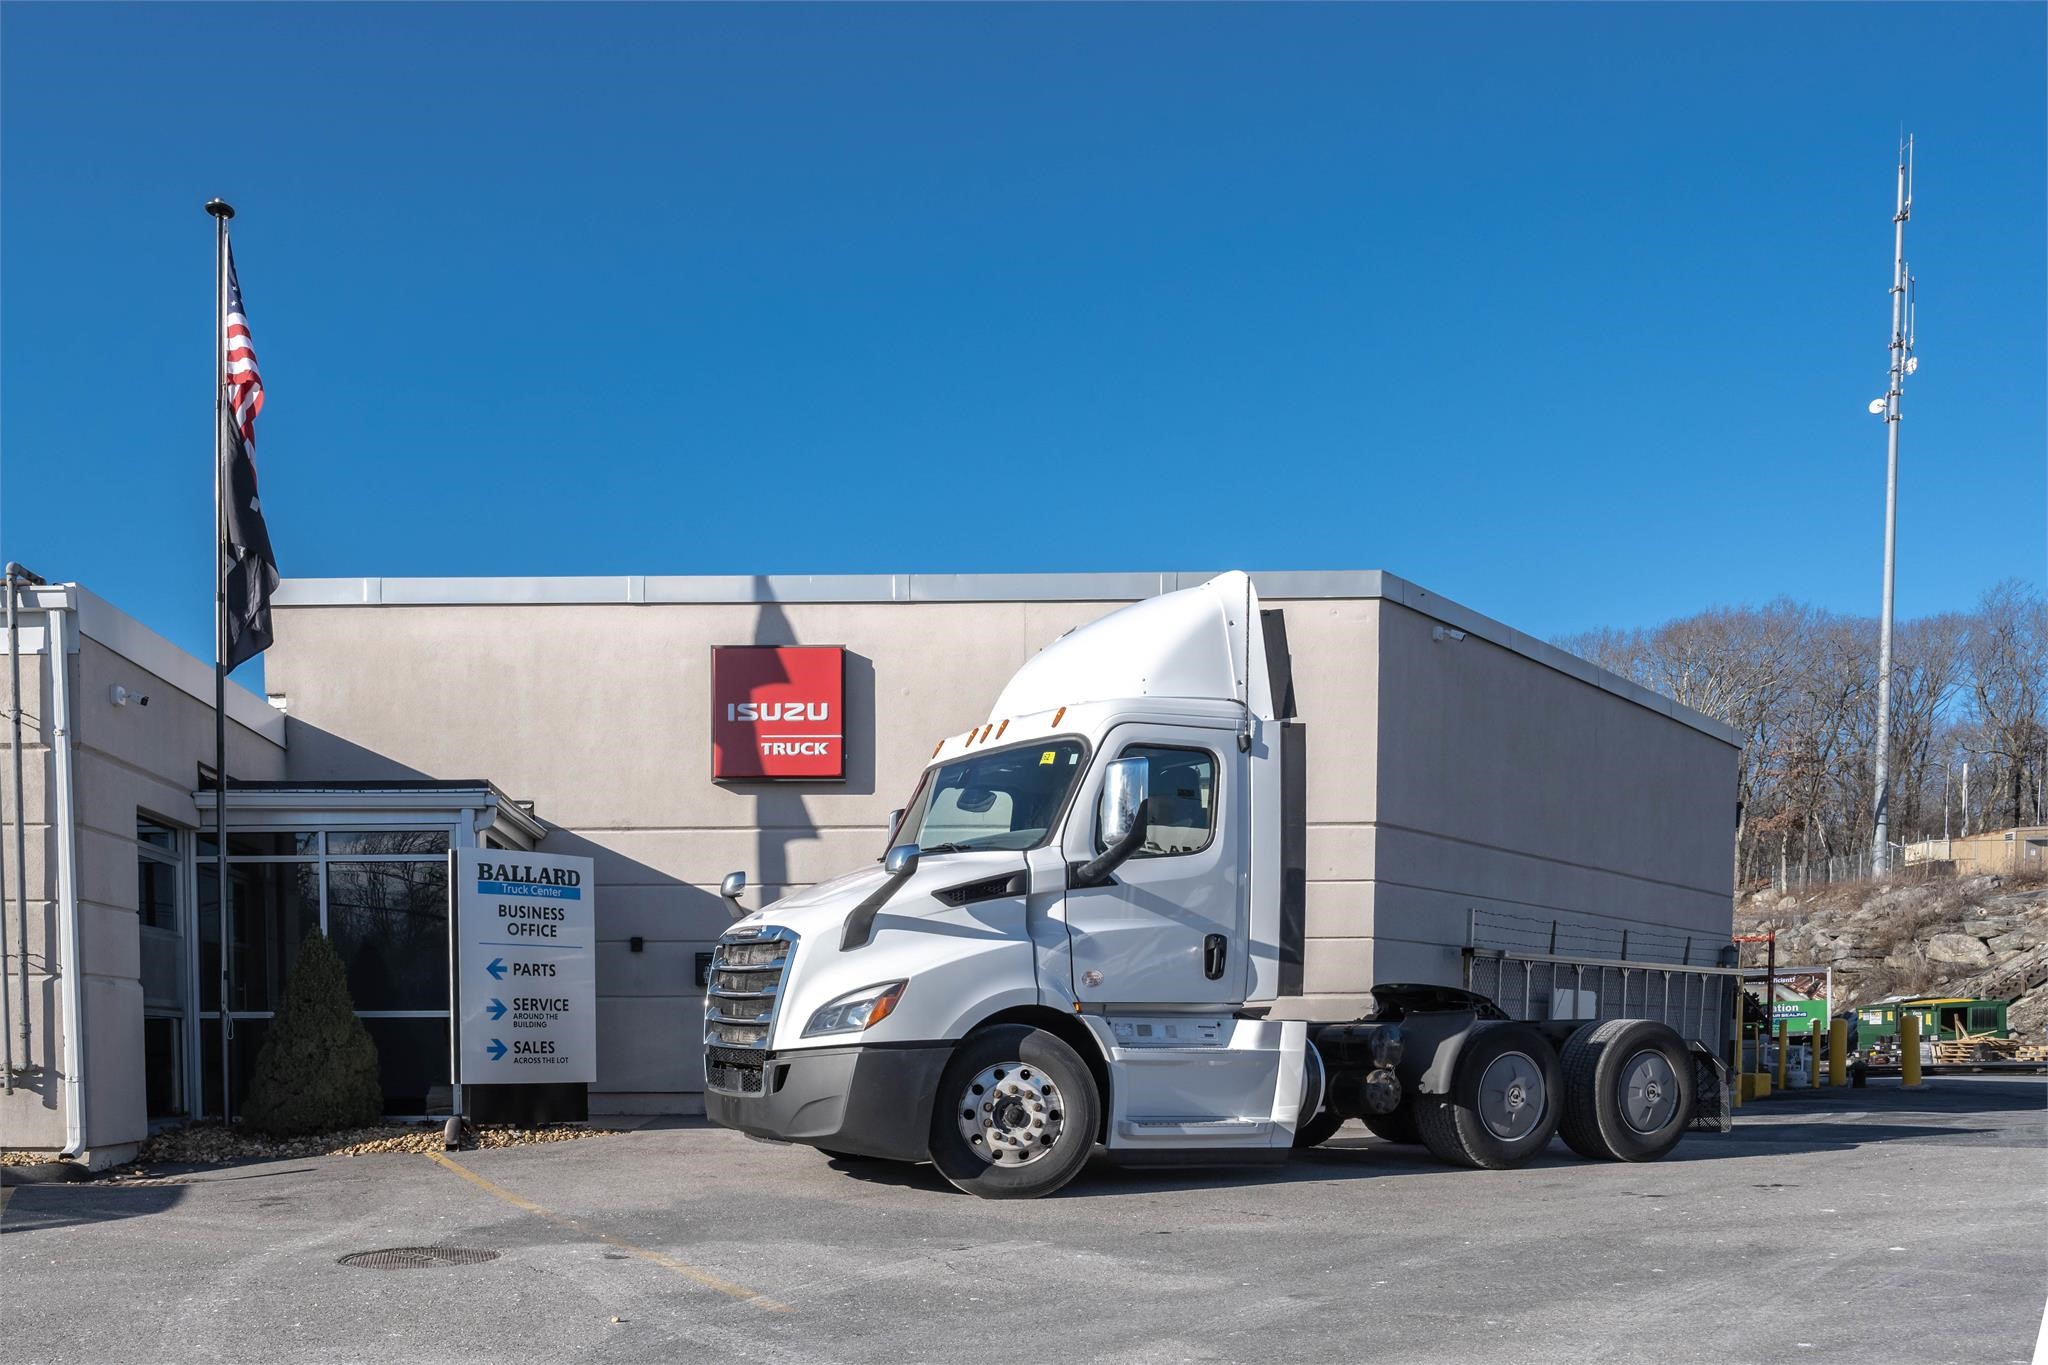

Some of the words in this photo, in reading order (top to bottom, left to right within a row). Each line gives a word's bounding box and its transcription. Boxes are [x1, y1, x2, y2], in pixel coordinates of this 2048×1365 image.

[728, 702, 828, 721] ISUZU
[761, 742, 829, 756] TRUCK
[478, 863, 580, 886] BALLARD
[502, 884, 529, 895] Truck
[531, 885, 562, 897] Center
[498, 904, 565, 921] BUSINESS
[507, 922, 557, 938] OFFICE
[513, 963, 556, 977] PARTS
[513, 998, 569, 1012] SERVICE
[513, 1012, 544, 1020] AROUND
[545, 1013, 558, 1021] THE
[513, 1040, 555, 1054] SALES
[513, 1056, 541, 1064] ACROSS
